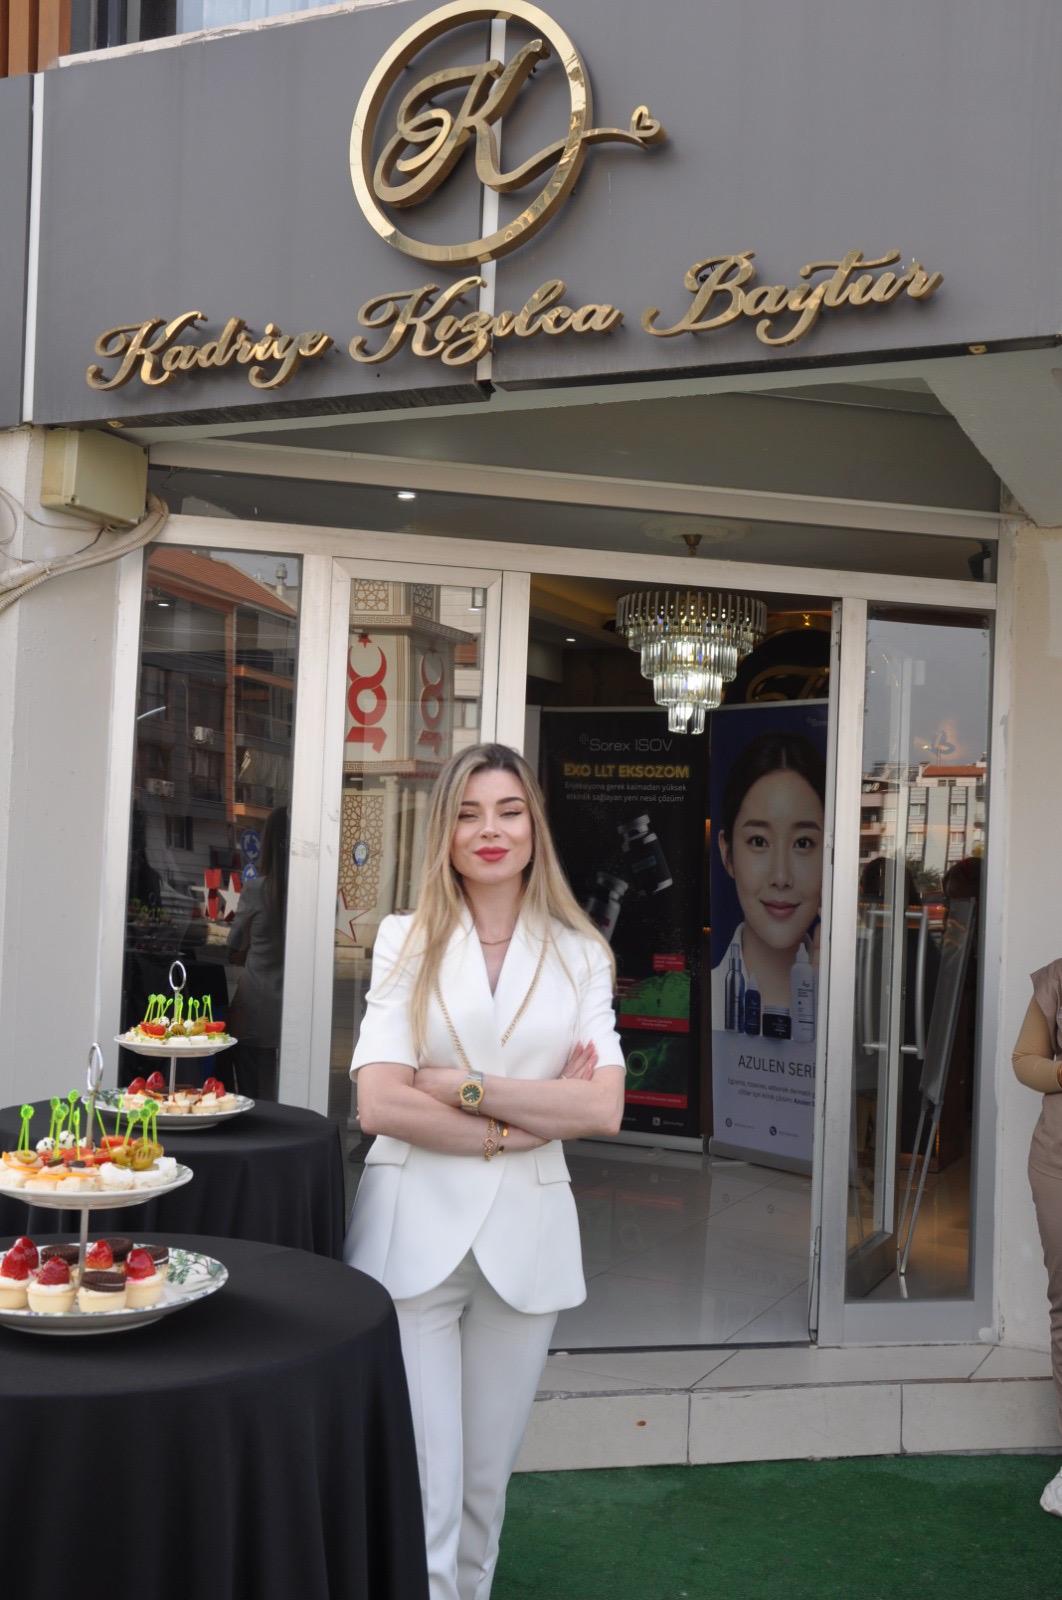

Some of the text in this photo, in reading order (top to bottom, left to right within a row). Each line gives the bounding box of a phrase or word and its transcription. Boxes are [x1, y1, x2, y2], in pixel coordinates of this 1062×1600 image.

[86, 310, 335, 392] Kadriye
[641, 249, 945, 346] Baytur
[589, 738, 673, 751] Sorex ISOV
[618, 764, 689, 779] EKSOZOM
[738, 1055, 785, 1074] AZULEN
